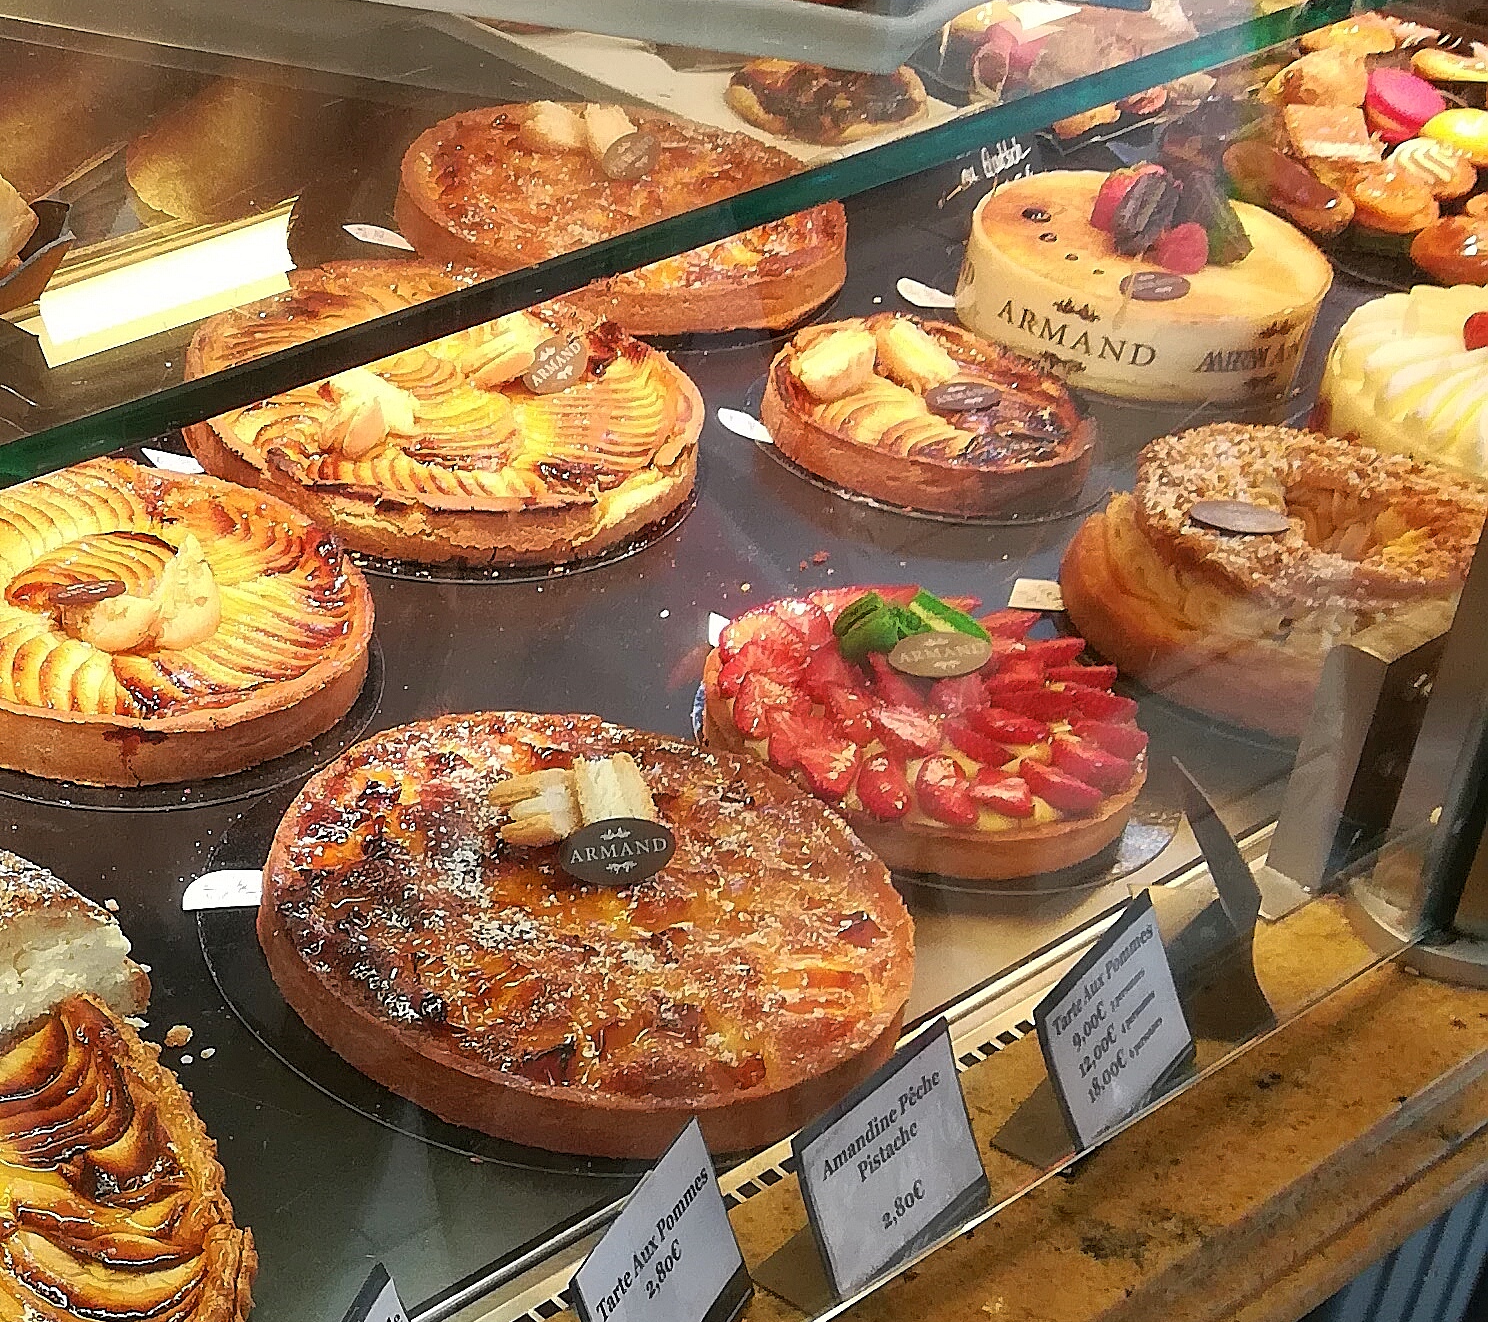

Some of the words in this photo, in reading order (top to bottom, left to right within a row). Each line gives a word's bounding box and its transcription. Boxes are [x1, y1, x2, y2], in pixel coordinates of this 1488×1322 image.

[532, 339, 581, 387] ARMAND
[997, 300, 1157, 367] ARMAND
[898, 643, 986, 664] ARMAND
[569, 836, 668, 865] ARMAND
[1052, 998, 1083, 1036] Tarte
[1083, 973, 1105, 1006] Aux
[1105, 924, 1153, 979] Pommes
[1072, 1000, 1107, 1053] 9,00€
[1079, 1022, 1117, 1078] 12,00€
[822, 1108, 897, 1181] Amandine
[899, 1070, 940, 1118] Pêche
[857, 1120, 918, 1183] Pistache
[881, 1179, 926, 1229] 2,80€
[595, 1268, 633, 1322] Tarte
[632, 1235, 659, 1279] Aux
[656, 1167, 709, 1243] Pommes
[644, 1238, 682, 1300] 2,80€
